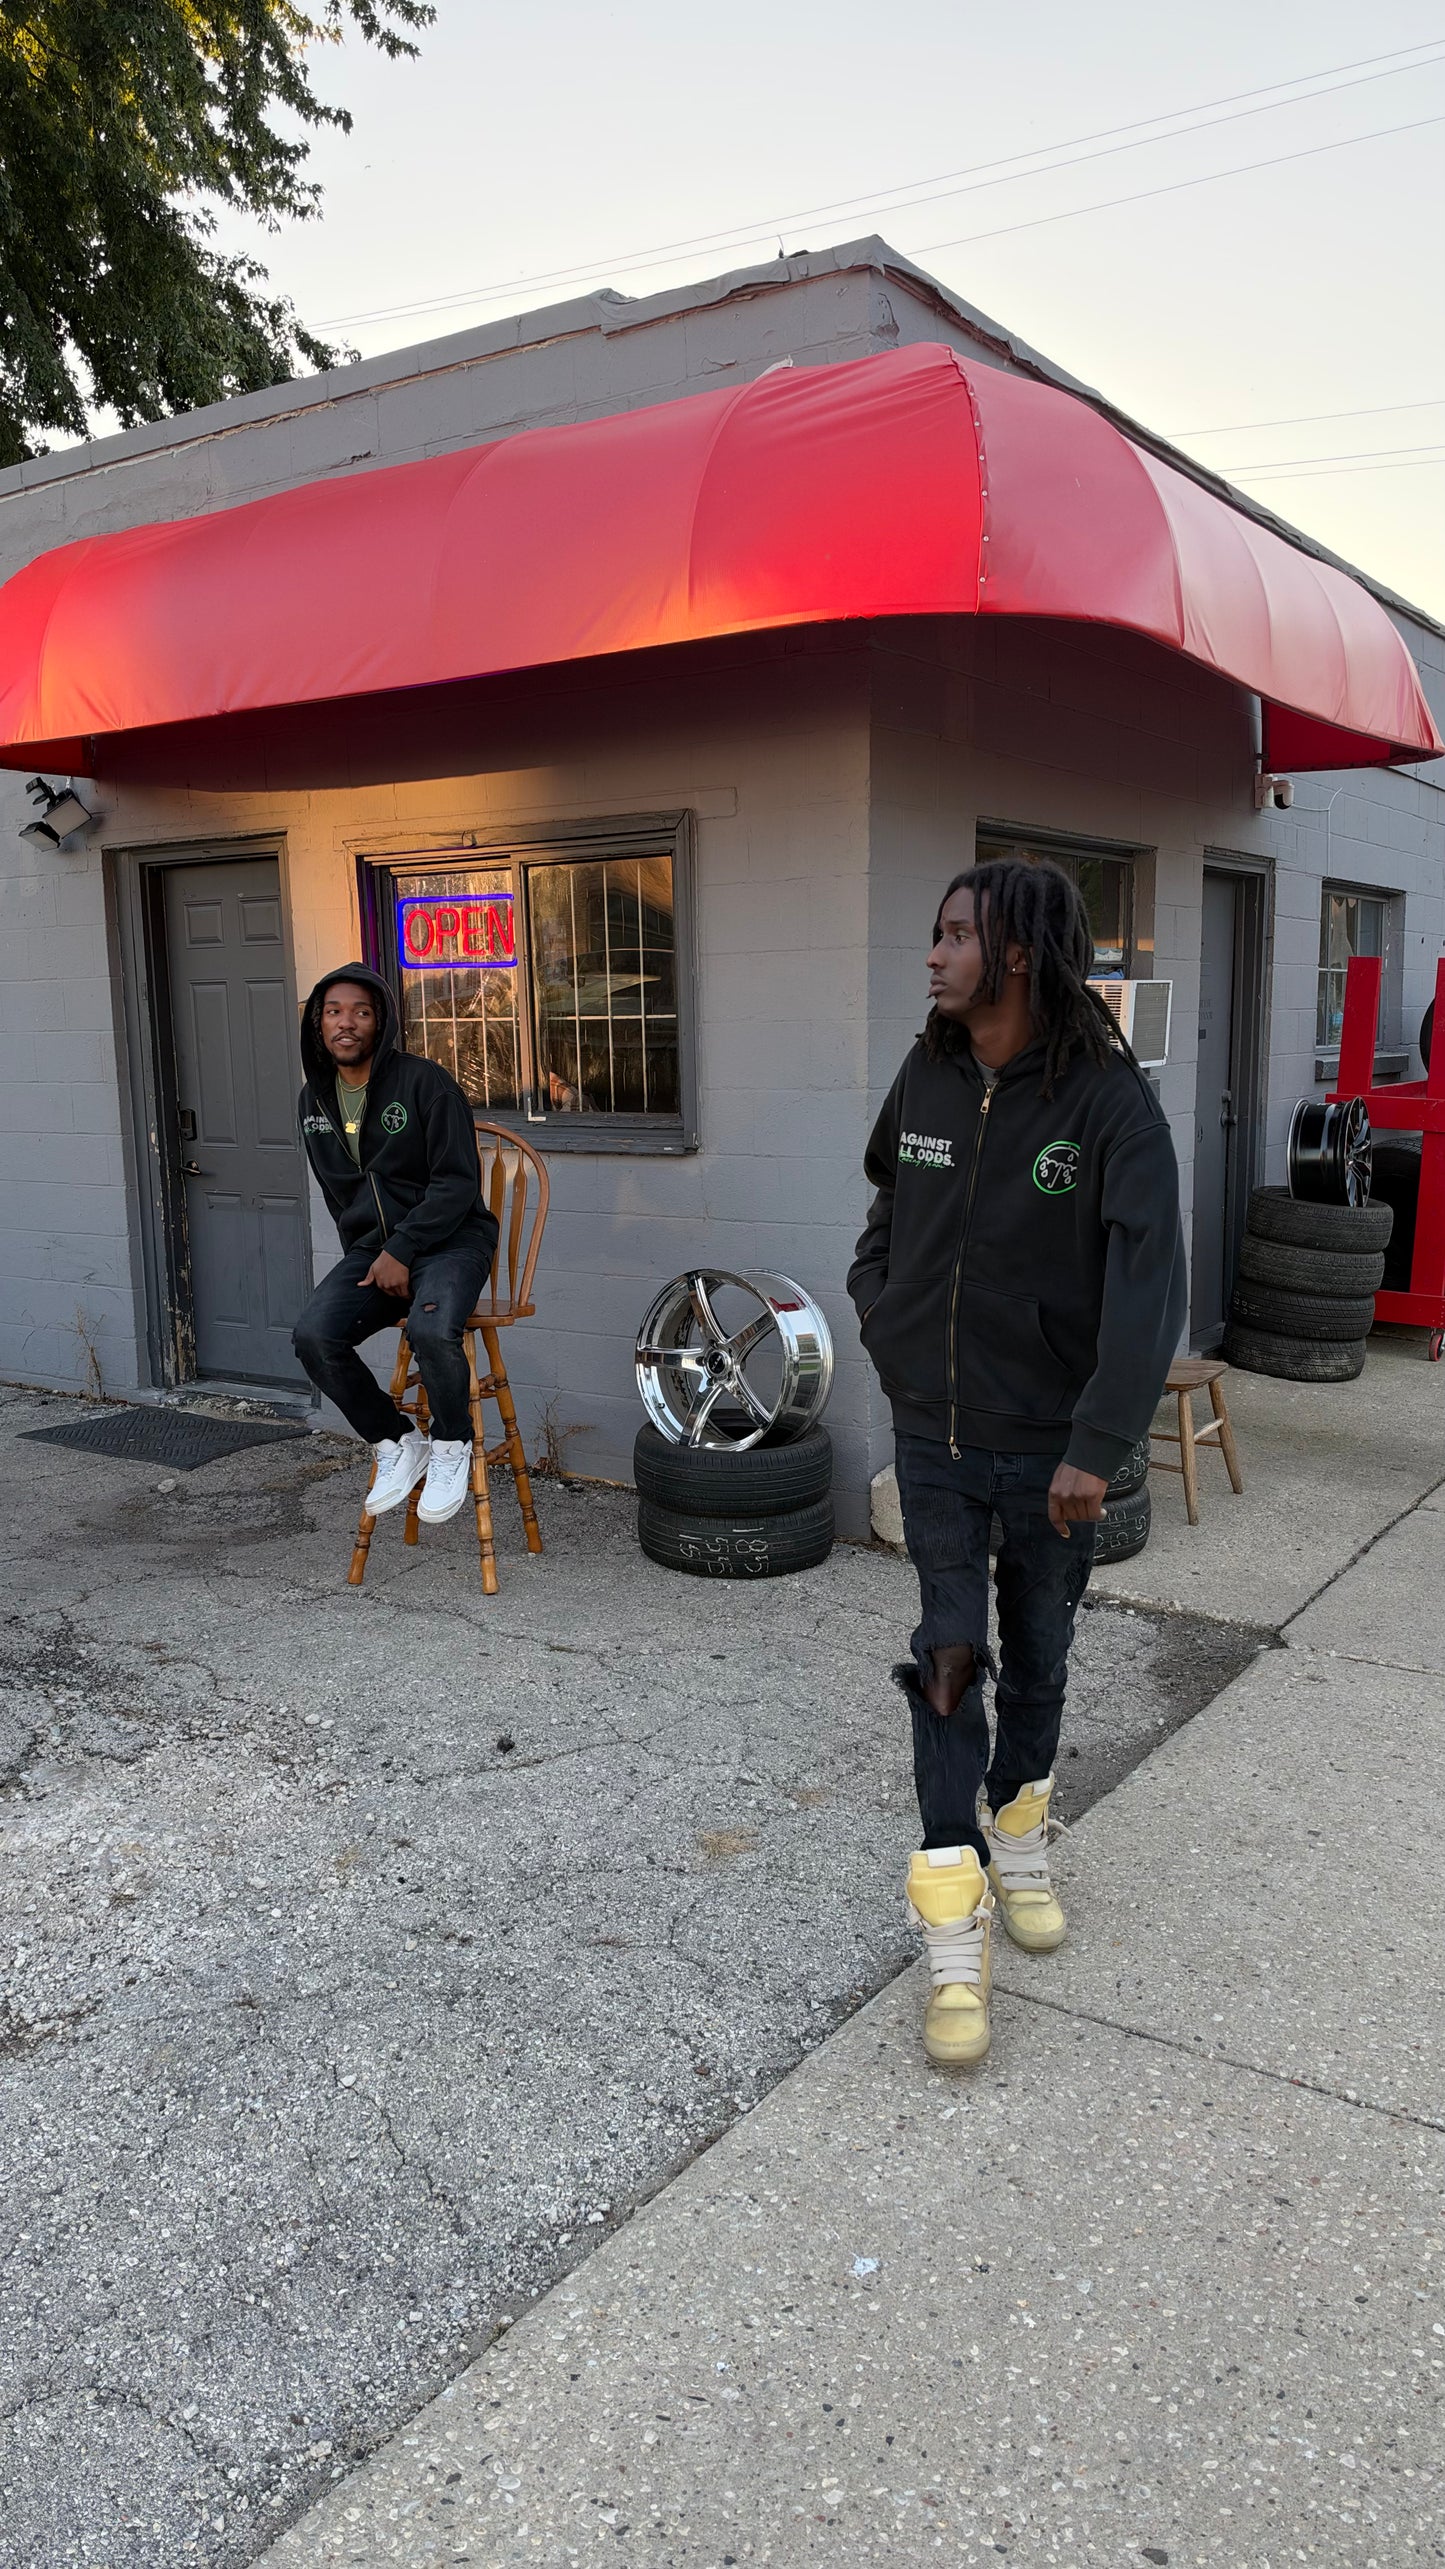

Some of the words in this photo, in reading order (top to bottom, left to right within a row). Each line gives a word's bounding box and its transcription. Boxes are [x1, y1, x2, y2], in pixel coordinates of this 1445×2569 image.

[404, 905, 515, 957] OPEN
[900, 1131, 953, 1153] AGAINST
[917, 1148, 956, 1167] ODDS.
